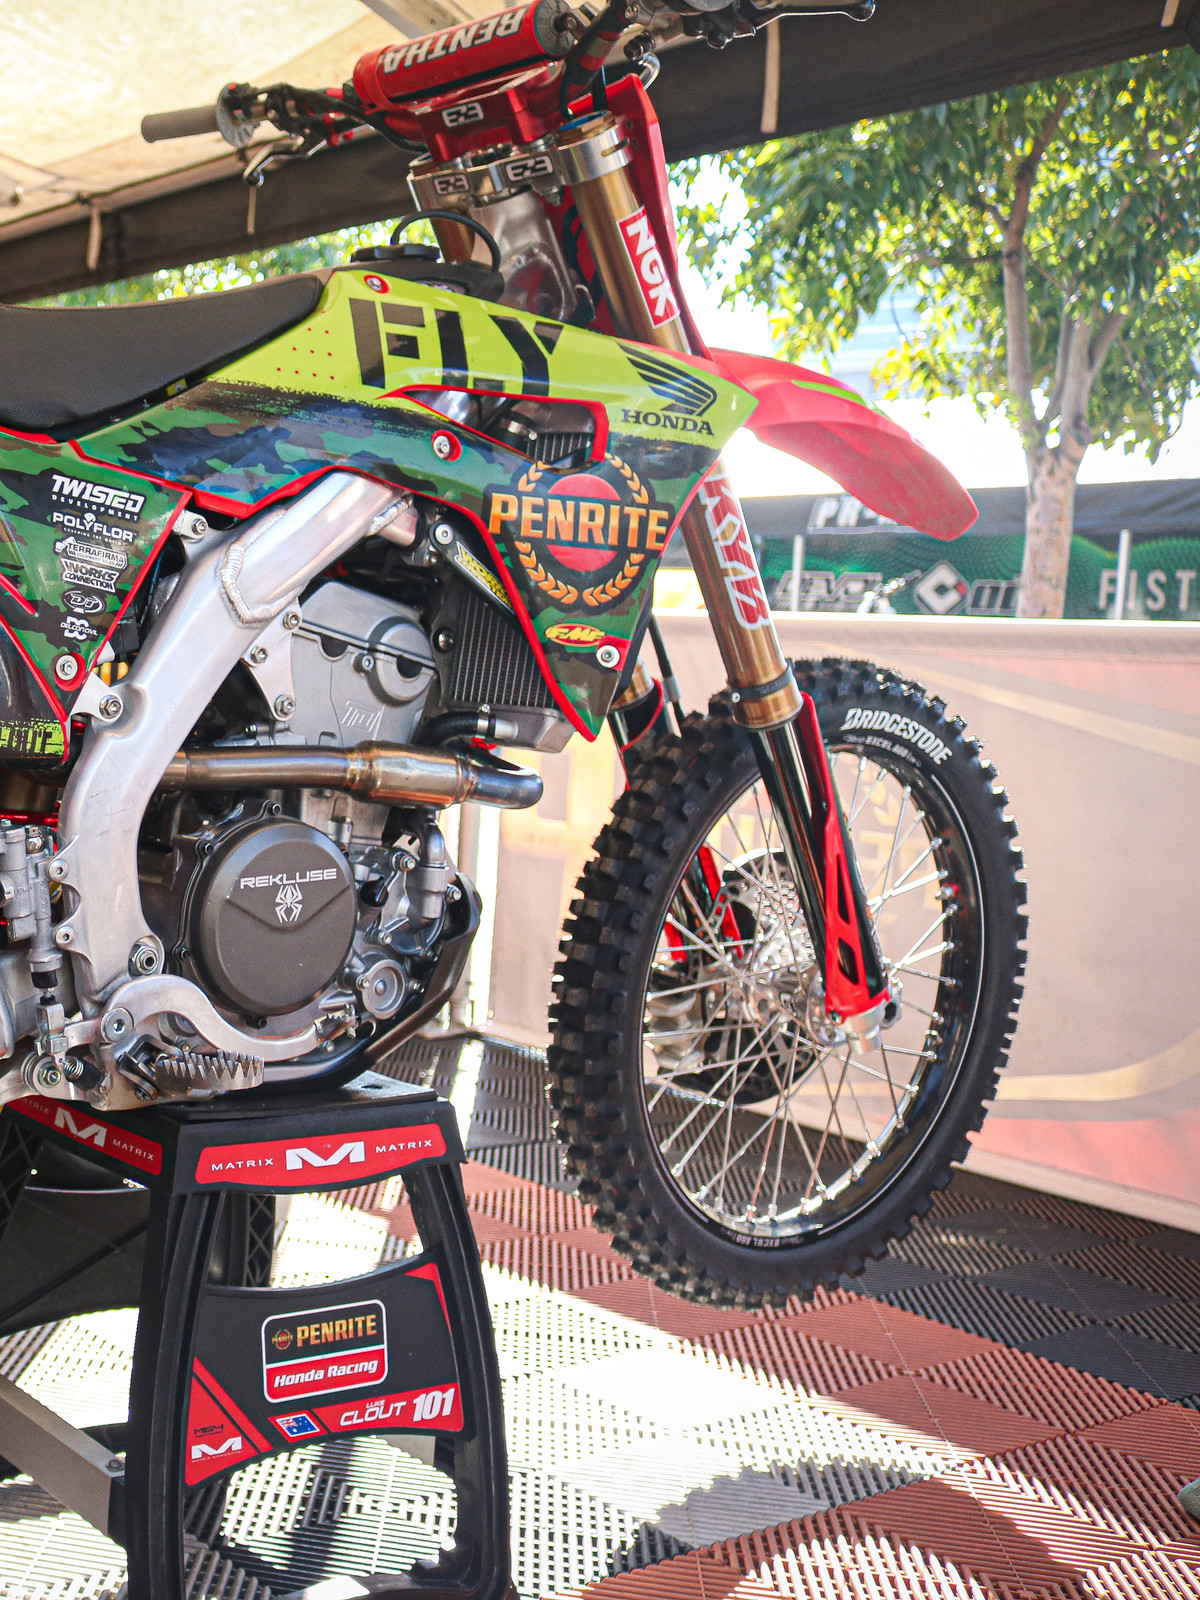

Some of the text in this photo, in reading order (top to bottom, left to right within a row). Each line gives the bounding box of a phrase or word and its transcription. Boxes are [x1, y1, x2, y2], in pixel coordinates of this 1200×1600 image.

[379, 8, 529, 75] RENTHA
[626, 216, 680, 318] NGK
[349, 297, 564, 397] FLY
[621, 409, 715, 436] HONDA
[52, 494, 138, 522] DEVELOPMENT
[488, 492, 670, 550] PENRITE
[52, 511, 137, 543] POLYFLOR
[65, 561, 117, 581] WORKS
[1098, 568, 1197, 612] FIST
[840, 707, 952, 765] BRIDGESTONE
[240, 867, 337, 890] REKLUSE
[112, 1138, 155, 1161] MATRIX
[211, 1157, 274, 1172] MATRIX
[375, 1139, 432, 1153] MATRIX
[296, 1315, 377, 1348] PENRITE
[273, 1359, 379, 1388] Honda Racing
[339, 1388, 456, 1427] CLOUT 101
